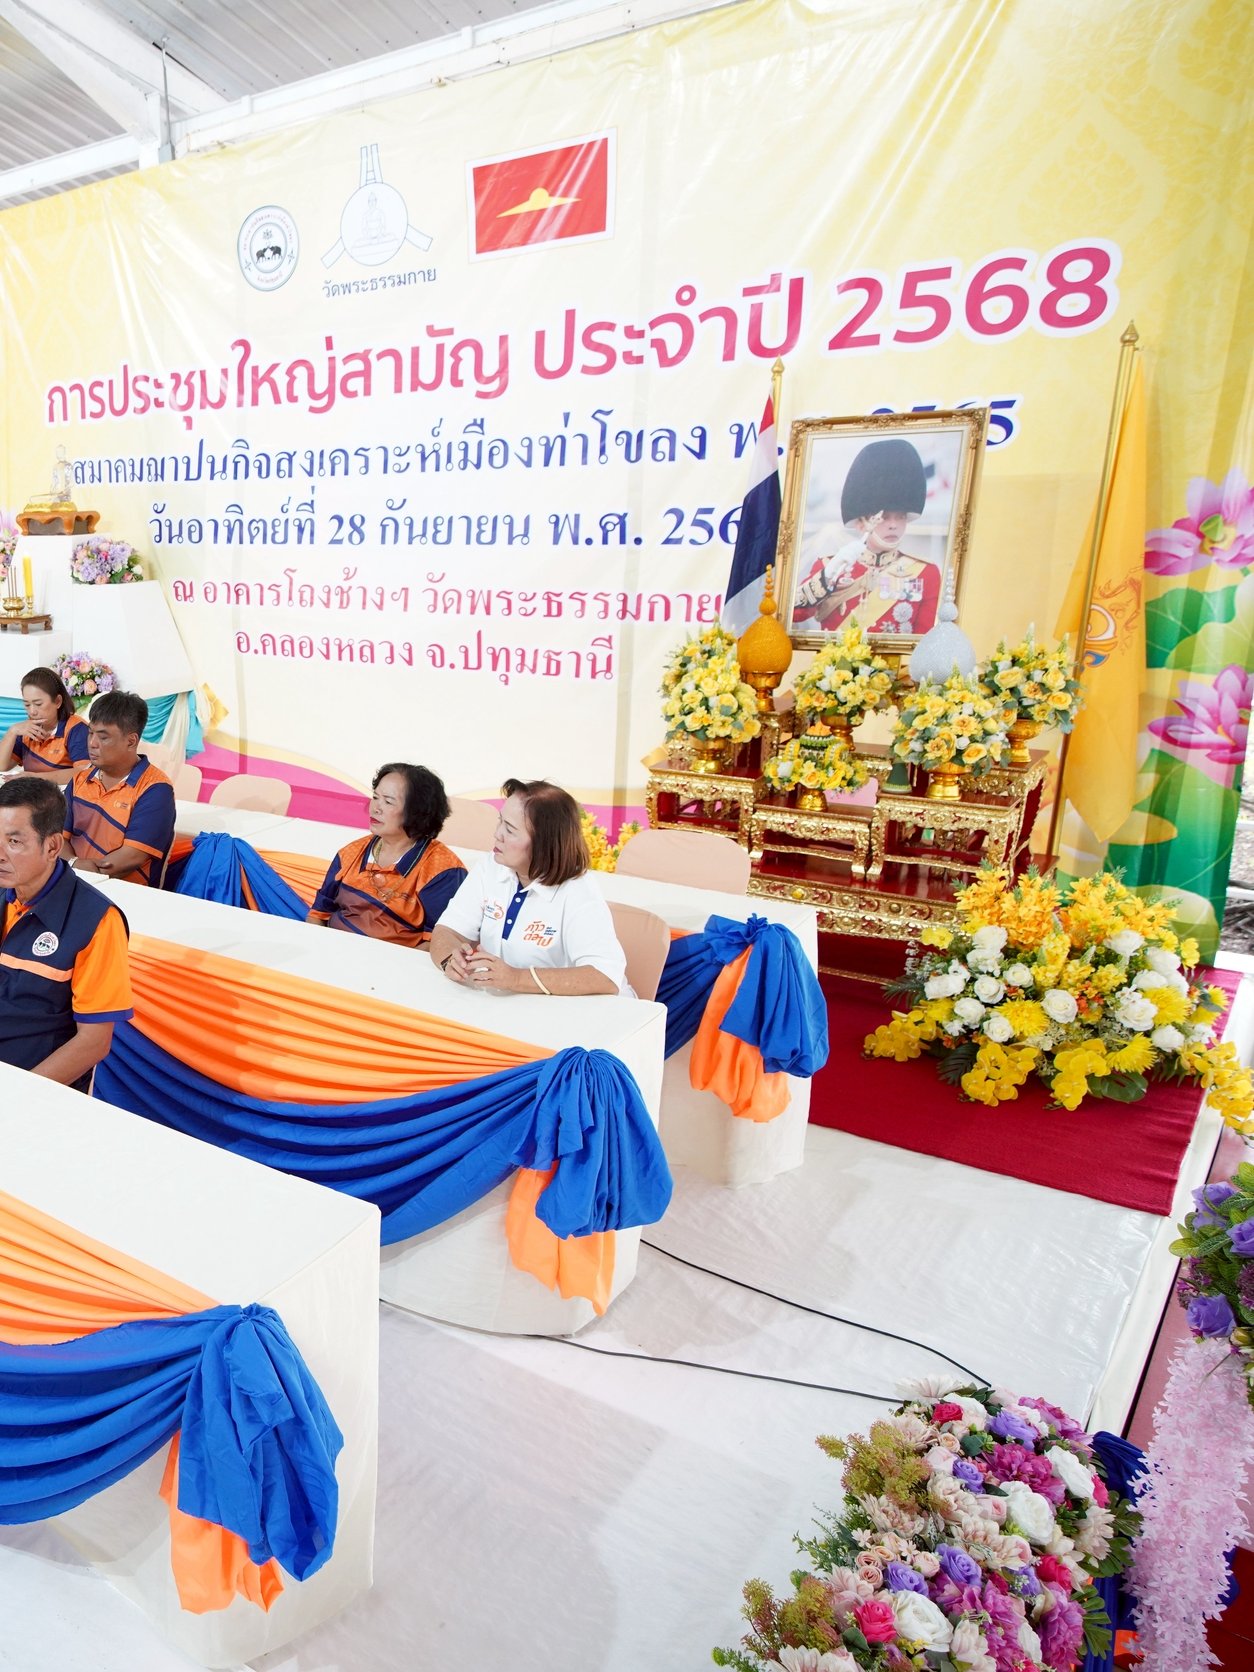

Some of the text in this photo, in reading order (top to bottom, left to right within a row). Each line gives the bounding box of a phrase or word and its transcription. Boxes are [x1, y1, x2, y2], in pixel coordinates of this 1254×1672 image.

[322, 268, 437, 298] วัดพระธรรมกาย
[47, 247, 1111, 430] การประชุมใหญ่สามัญ ประจำปี 2568
[73, 408, 708, 485] สมาคมฌาปนกิจสงเคราะห์เมืองท่าโขลง
[149, 486, 744, 546] วันอาทิตย์ที่ 28 กันยายน พ.ศ. 256
[173, 567, 722, 623] ณ อาคารโถงช้างฯ วัดพระธรรมกาย
[236, 630, 614, 686] อ.คลองหลวง จ.ปทุมธานี
